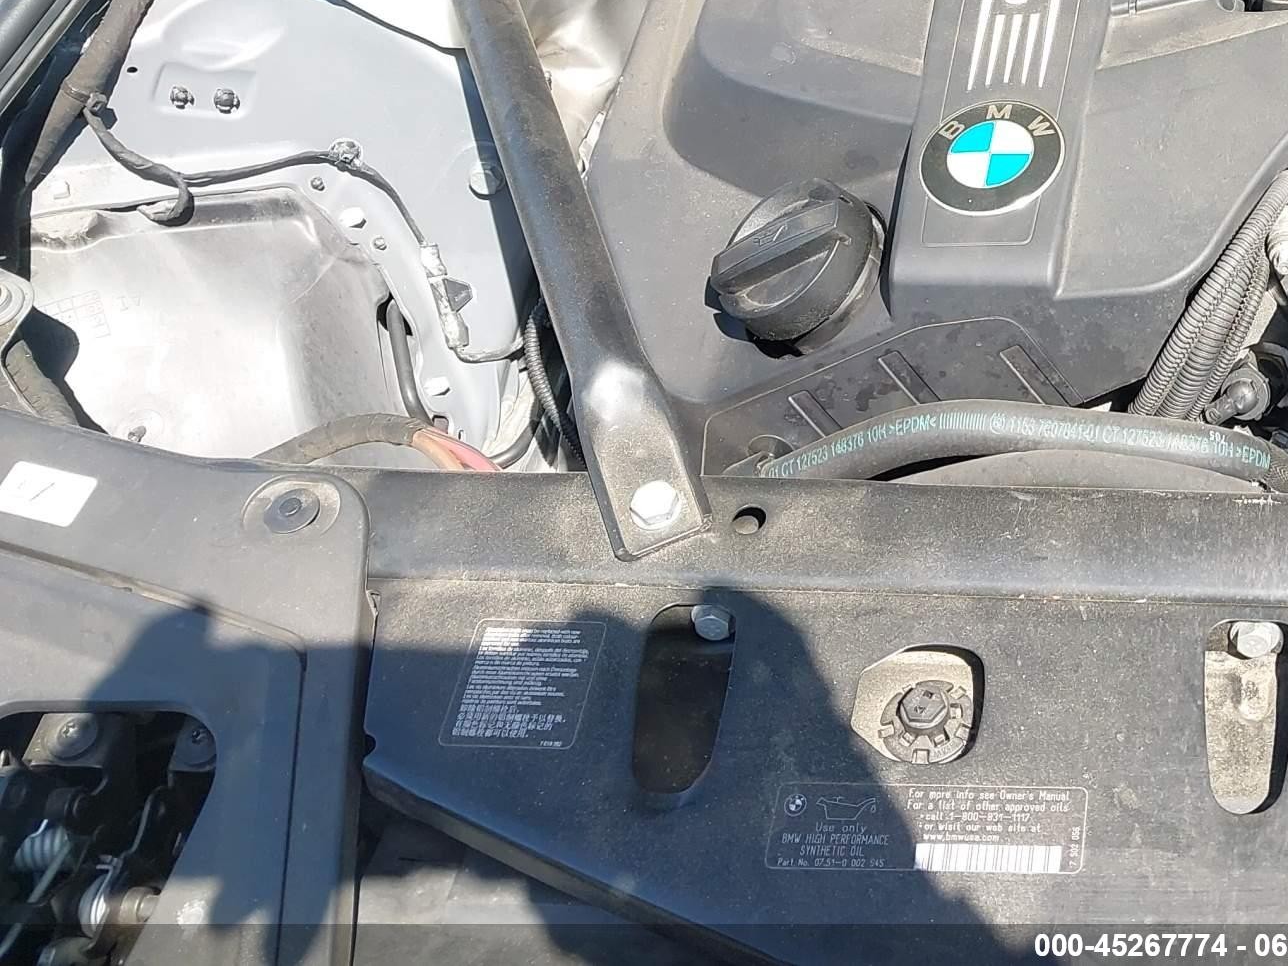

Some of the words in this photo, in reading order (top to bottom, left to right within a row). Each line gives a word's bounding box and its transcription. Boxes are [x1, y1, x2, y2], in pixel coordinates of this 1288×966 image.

[938, 104, 1057, 140] BMW
[909, 788, 924, 798] For
[956, 789, 974, 799] info
[979, 791, 994, 800] see
[1000, 790, 1034, 800] Owner's
[1038, 790, 1070, 801] Manual
[907, 801, 924, 810] For
[960, 801, 972, 810] of
[976, 802, 999, 811] other
[1005, 802, 1045, 812] approved
[815, 822, 835, 832] Use
[842, 823, 867, 834] only
[782, 833, 800, 844] BMW
[805, 834, 827, 844] HIGH
[830, 834, 889, 845] PERFORMANCE
[800, 845, 846, 856] SYNTHETIC
[850, 846, 865, 856] OIL
